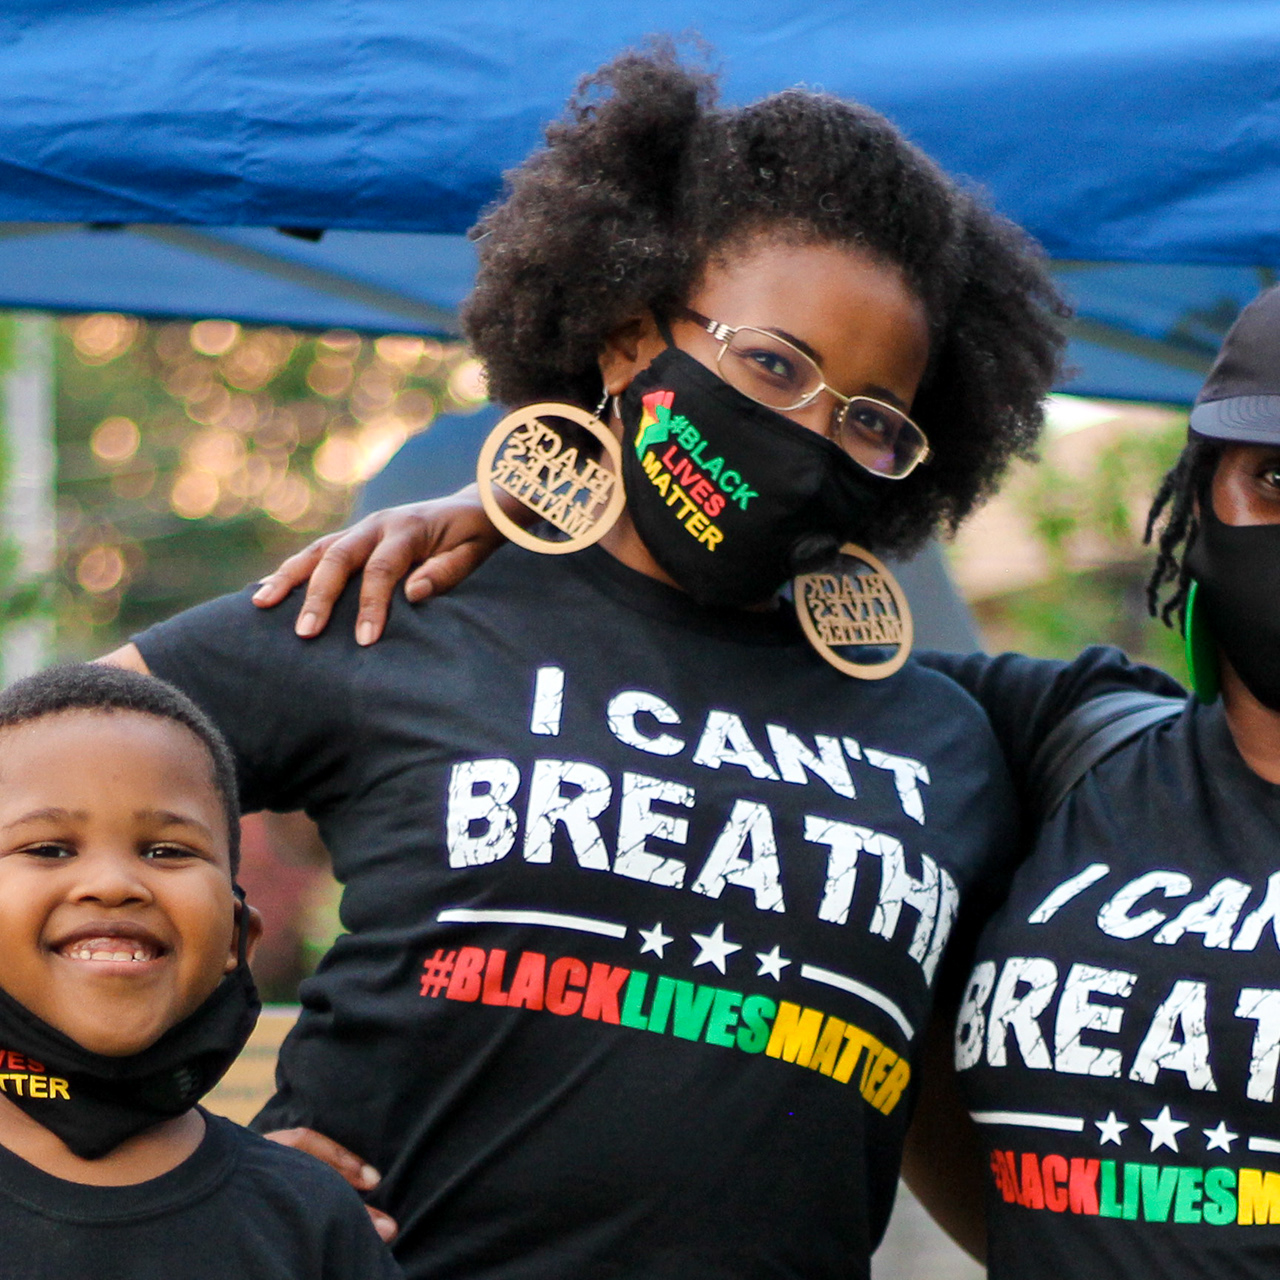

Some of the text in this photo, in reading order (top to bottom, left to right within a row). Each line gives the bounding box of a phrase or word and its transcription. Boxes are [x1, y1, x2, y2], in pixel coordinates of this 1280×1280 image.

[642, 451, 724, 552] MATTER
[661, 445, 726, 518] LIVES
[669, 414, 759, 511] #BLACK
[530, 665, 931, 826] I CAN'T
[1028, 862, 1110, 924] I
[419, 945, 912, 1116] #BLACKLIVESMATTER
